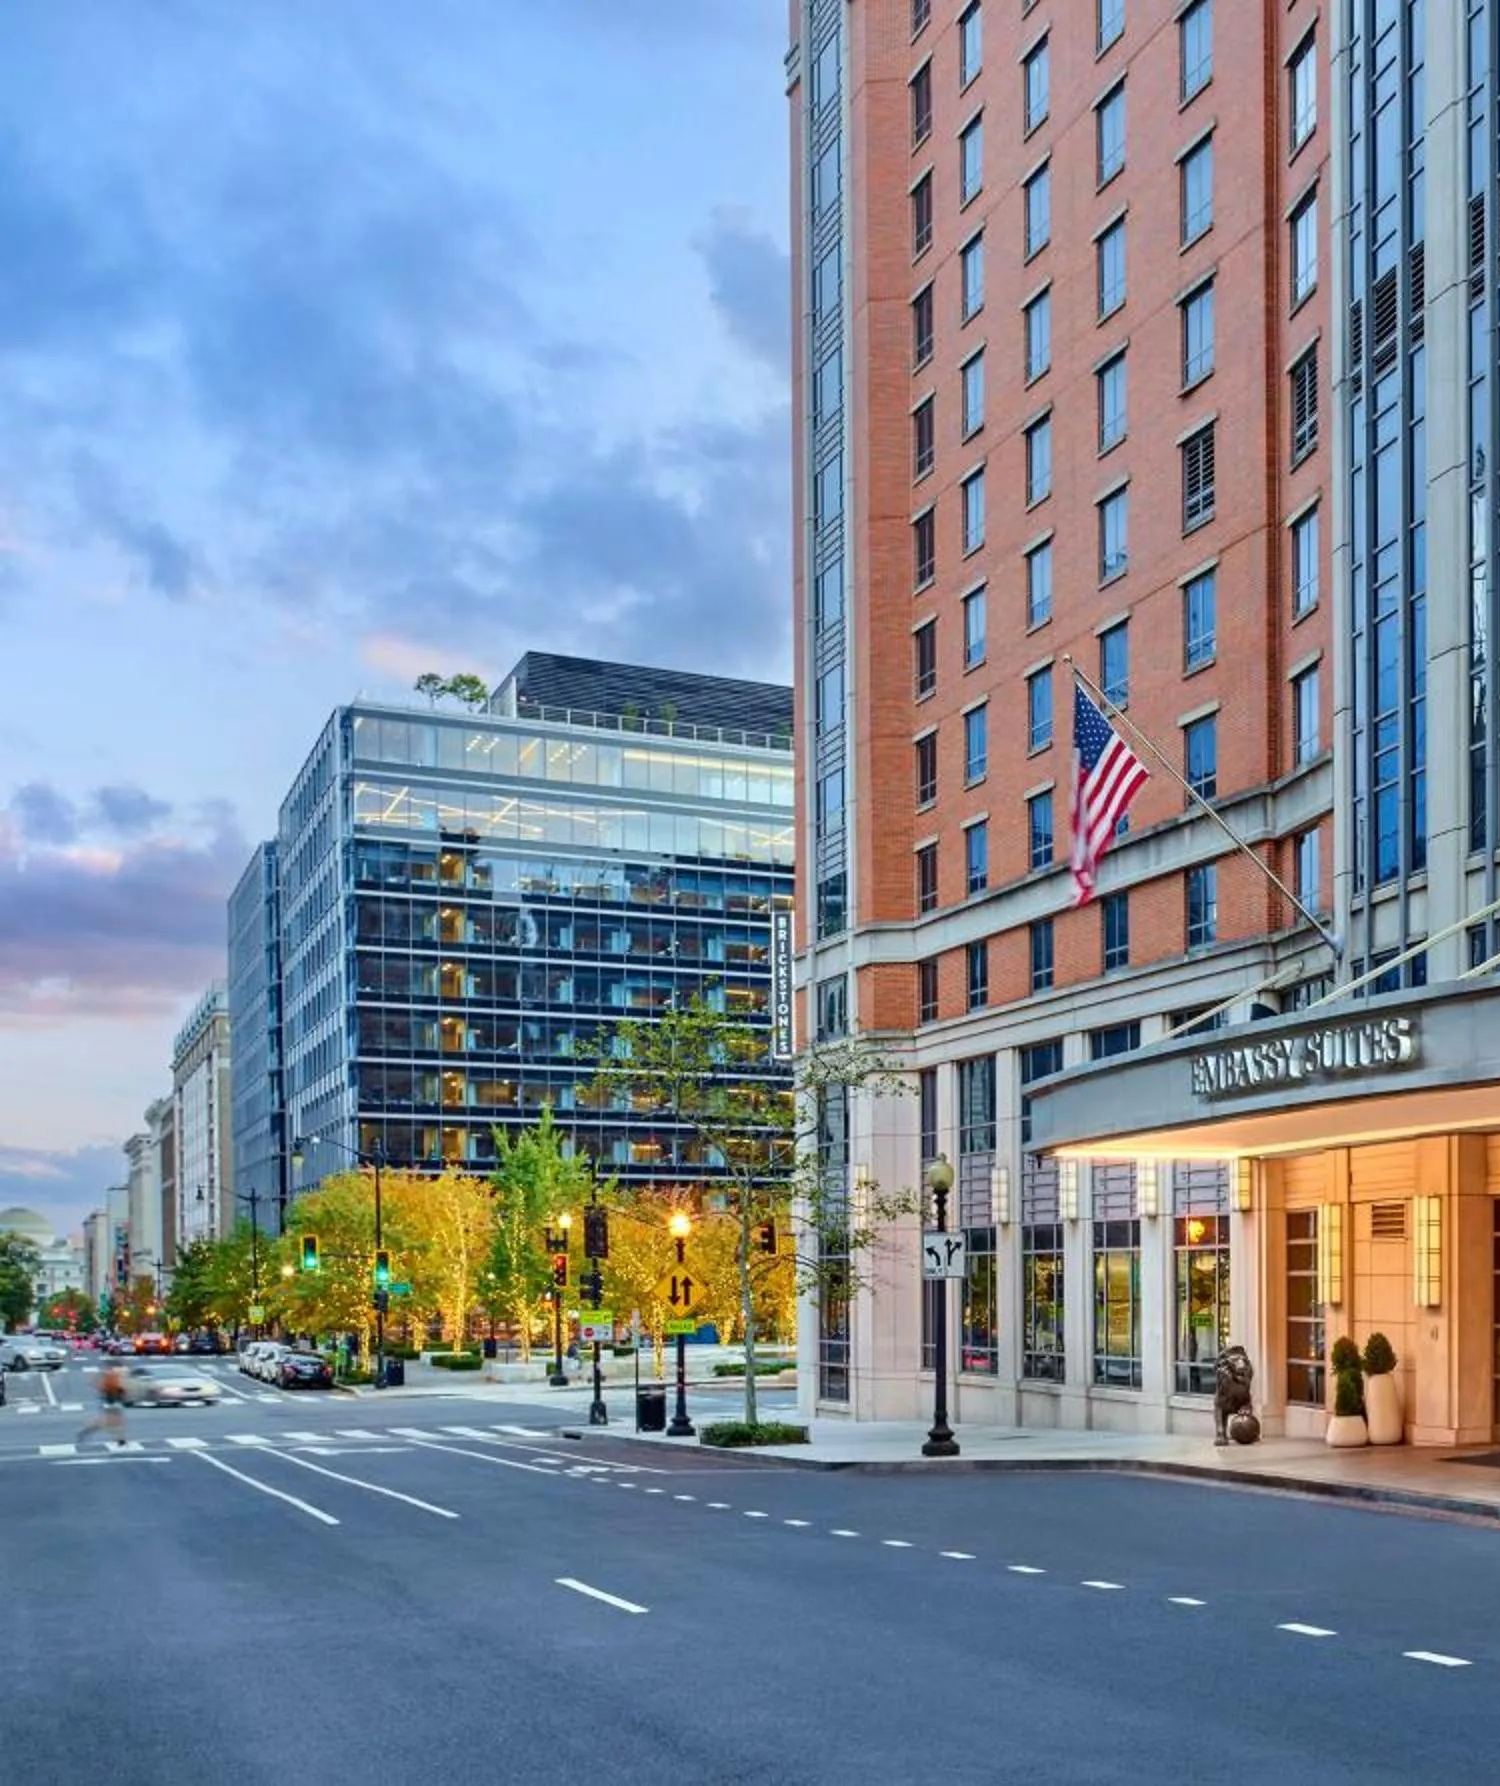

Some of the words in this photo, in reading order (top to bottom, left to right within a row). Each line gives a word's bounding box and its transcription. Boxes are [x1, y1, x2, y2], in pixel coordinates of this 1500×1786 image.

[777, 917, 789, 1053] BRICKSTONES
[1191, 1039, 1304, 1096] EMBASSY
[1306, 1017, 1414, 1072] SUITES
